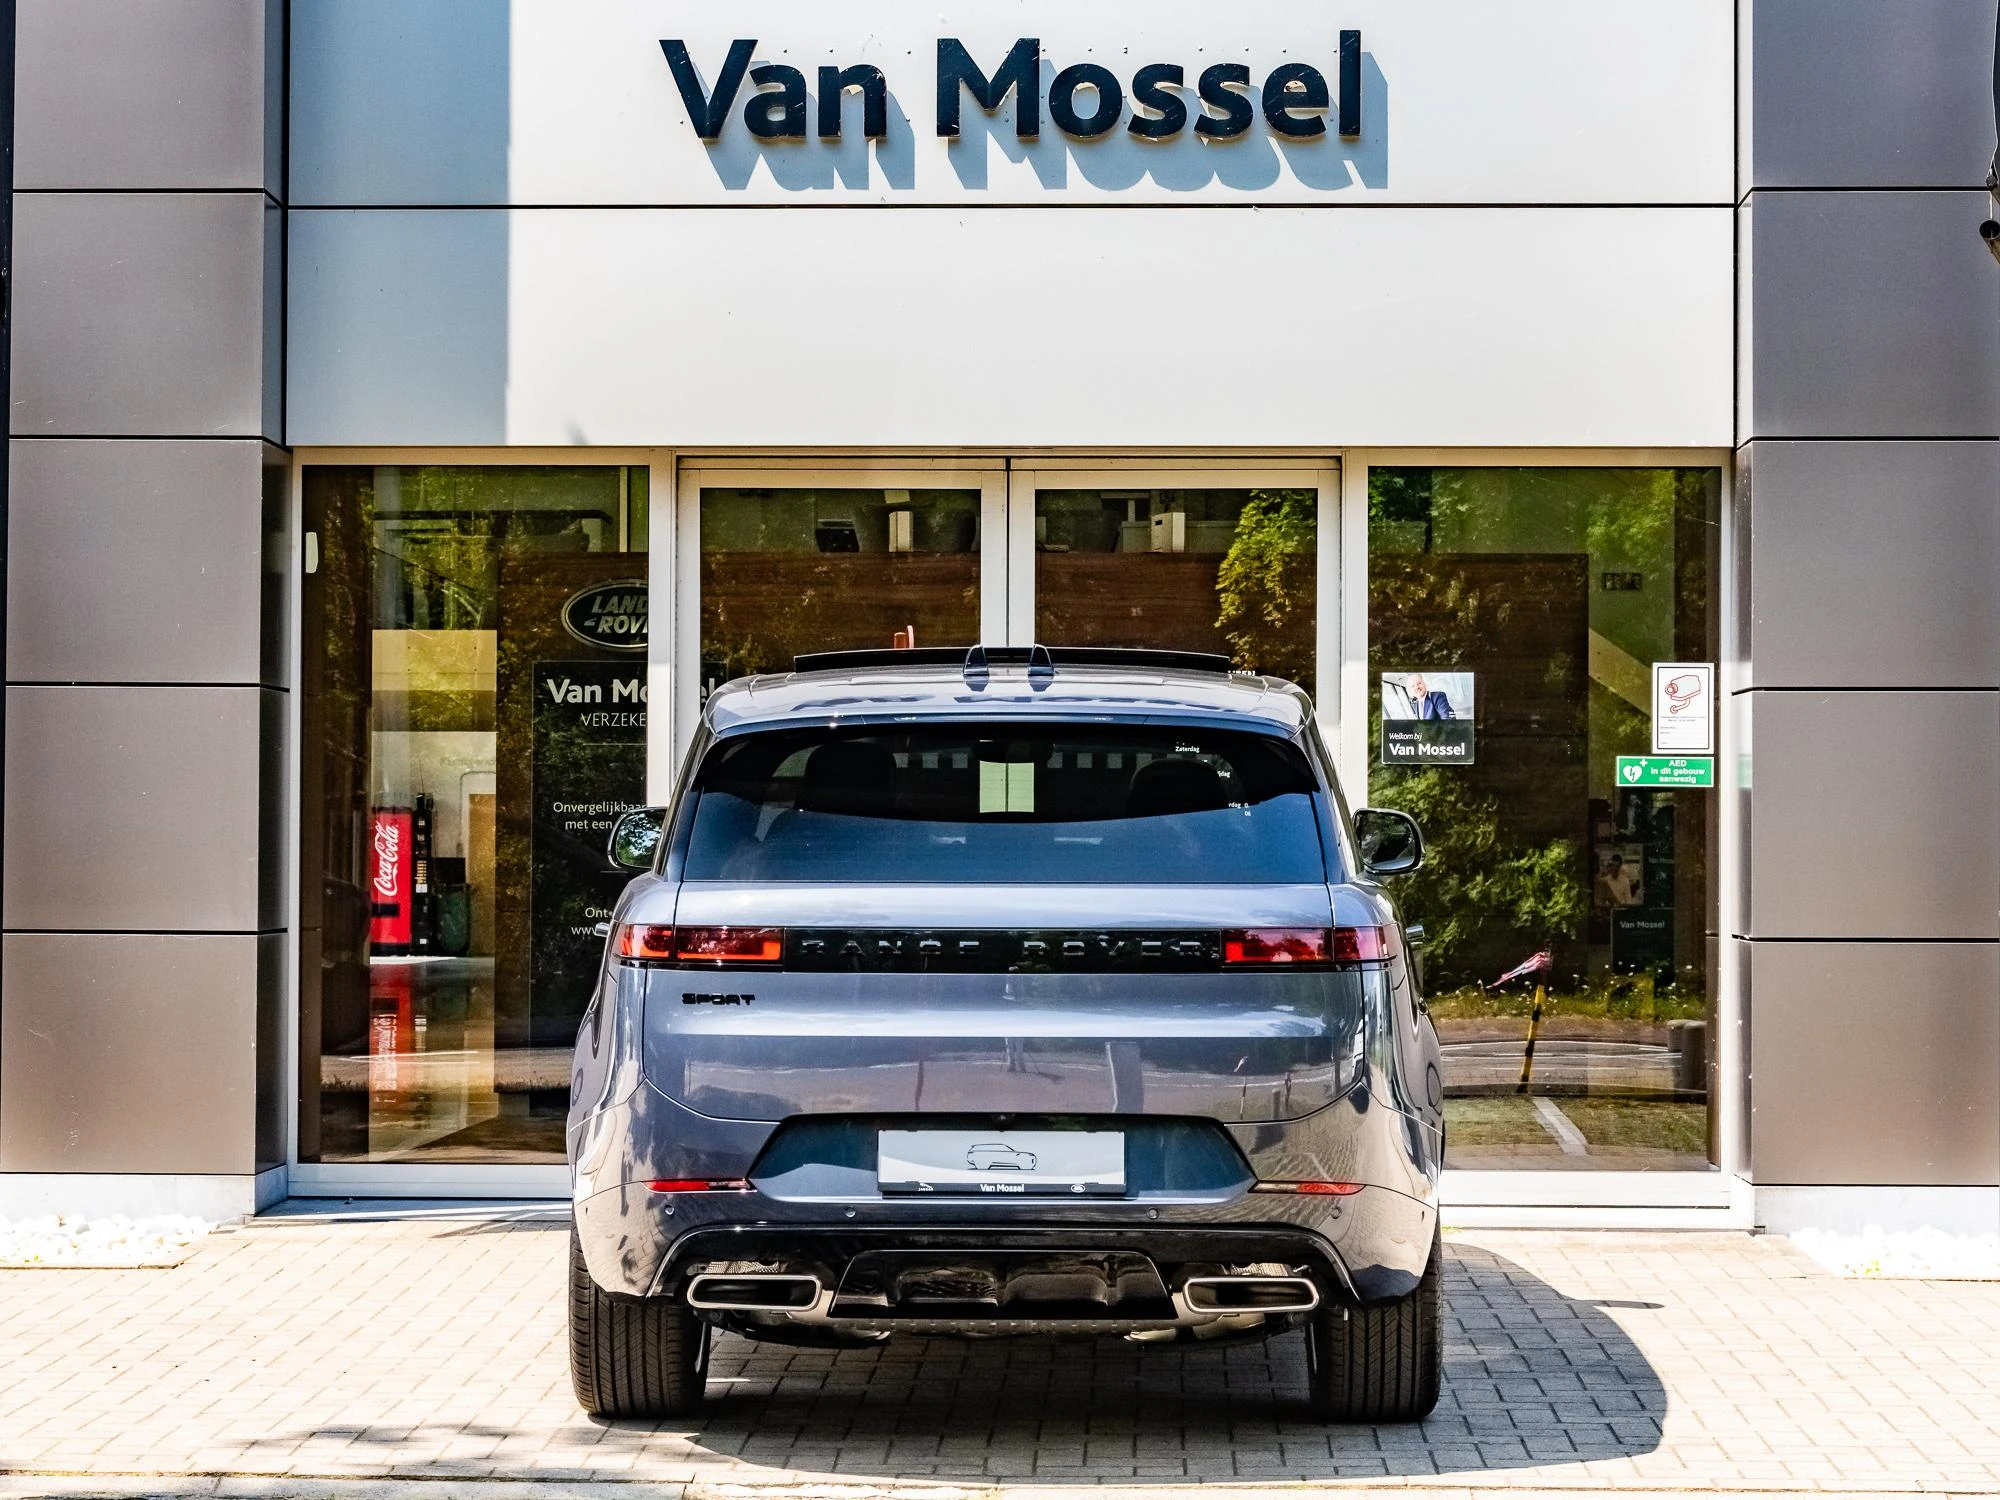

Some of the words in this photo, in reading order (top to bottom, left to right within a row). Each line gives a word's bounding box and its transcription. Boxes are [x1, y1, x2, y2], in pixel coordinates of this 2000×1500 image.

[659, 38, 887, 139] Van
[936, 29, 1361, 140] Mossel
[546, 678, 602, 703] Van
[581, 712, 646, 727] VERZEKE
[1389, 732, 1414, 740] Welkom
[1414, 732, 1422, 741] bij
[1175, 745, 1200, 753] Zaterdag
[1389, 743, 1415, 756] Van
[1418, 742, 1465, 756] Mossel
[1660, 767, 1672, 775] dit
[1673, 767, 1706, 777] gebouw
[1659, 775, 1697, 784] aanwezig
[565, 820, 589, 830] met
[592, 821, 613, 830] een
[373, 820, 398, 897] Coca-Cola
[1619, 920, 1635, 929] Van
[1637, 920, 1665, 929] Mossel
[681, 992, 756, 1006] SPORT
[980, 1184, 995, 1192] Van
[997, 1183, 1025, 1193] Mossel
